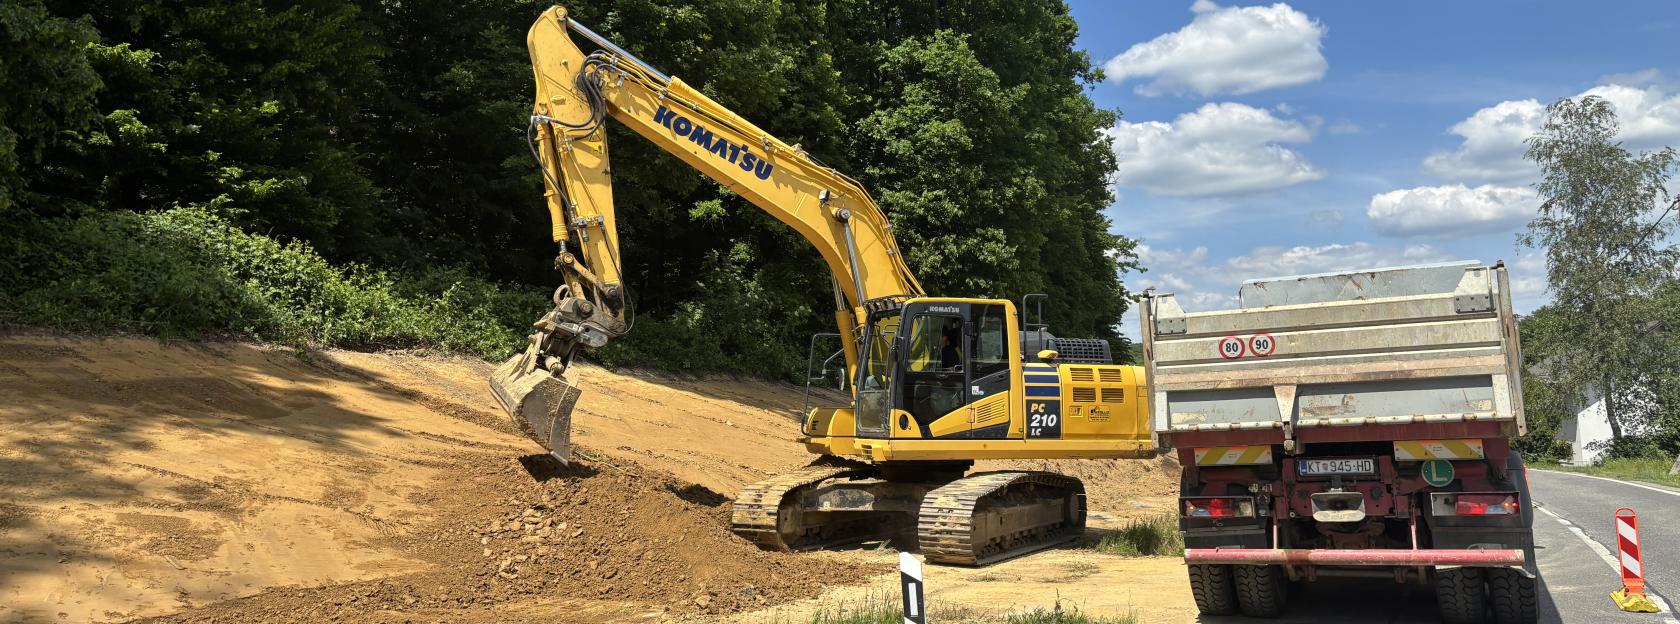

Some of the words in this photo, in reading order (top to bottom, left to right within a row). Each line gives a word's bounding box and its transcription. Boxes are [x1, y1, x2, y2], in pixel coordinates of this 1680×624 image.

[653, 104, 774, 180] KOMATSU
[1225, 342, 1239, 353] 80
[1255, 339, 1269, 350] 90
[1030, 403, 1046, 413] PC
[1030, 414, 1057, 427] 210
[1030, 428, 1042, 436] LC
[1308, 461, 1321, 473] KT
[1431, 460, 1448, 482] L
